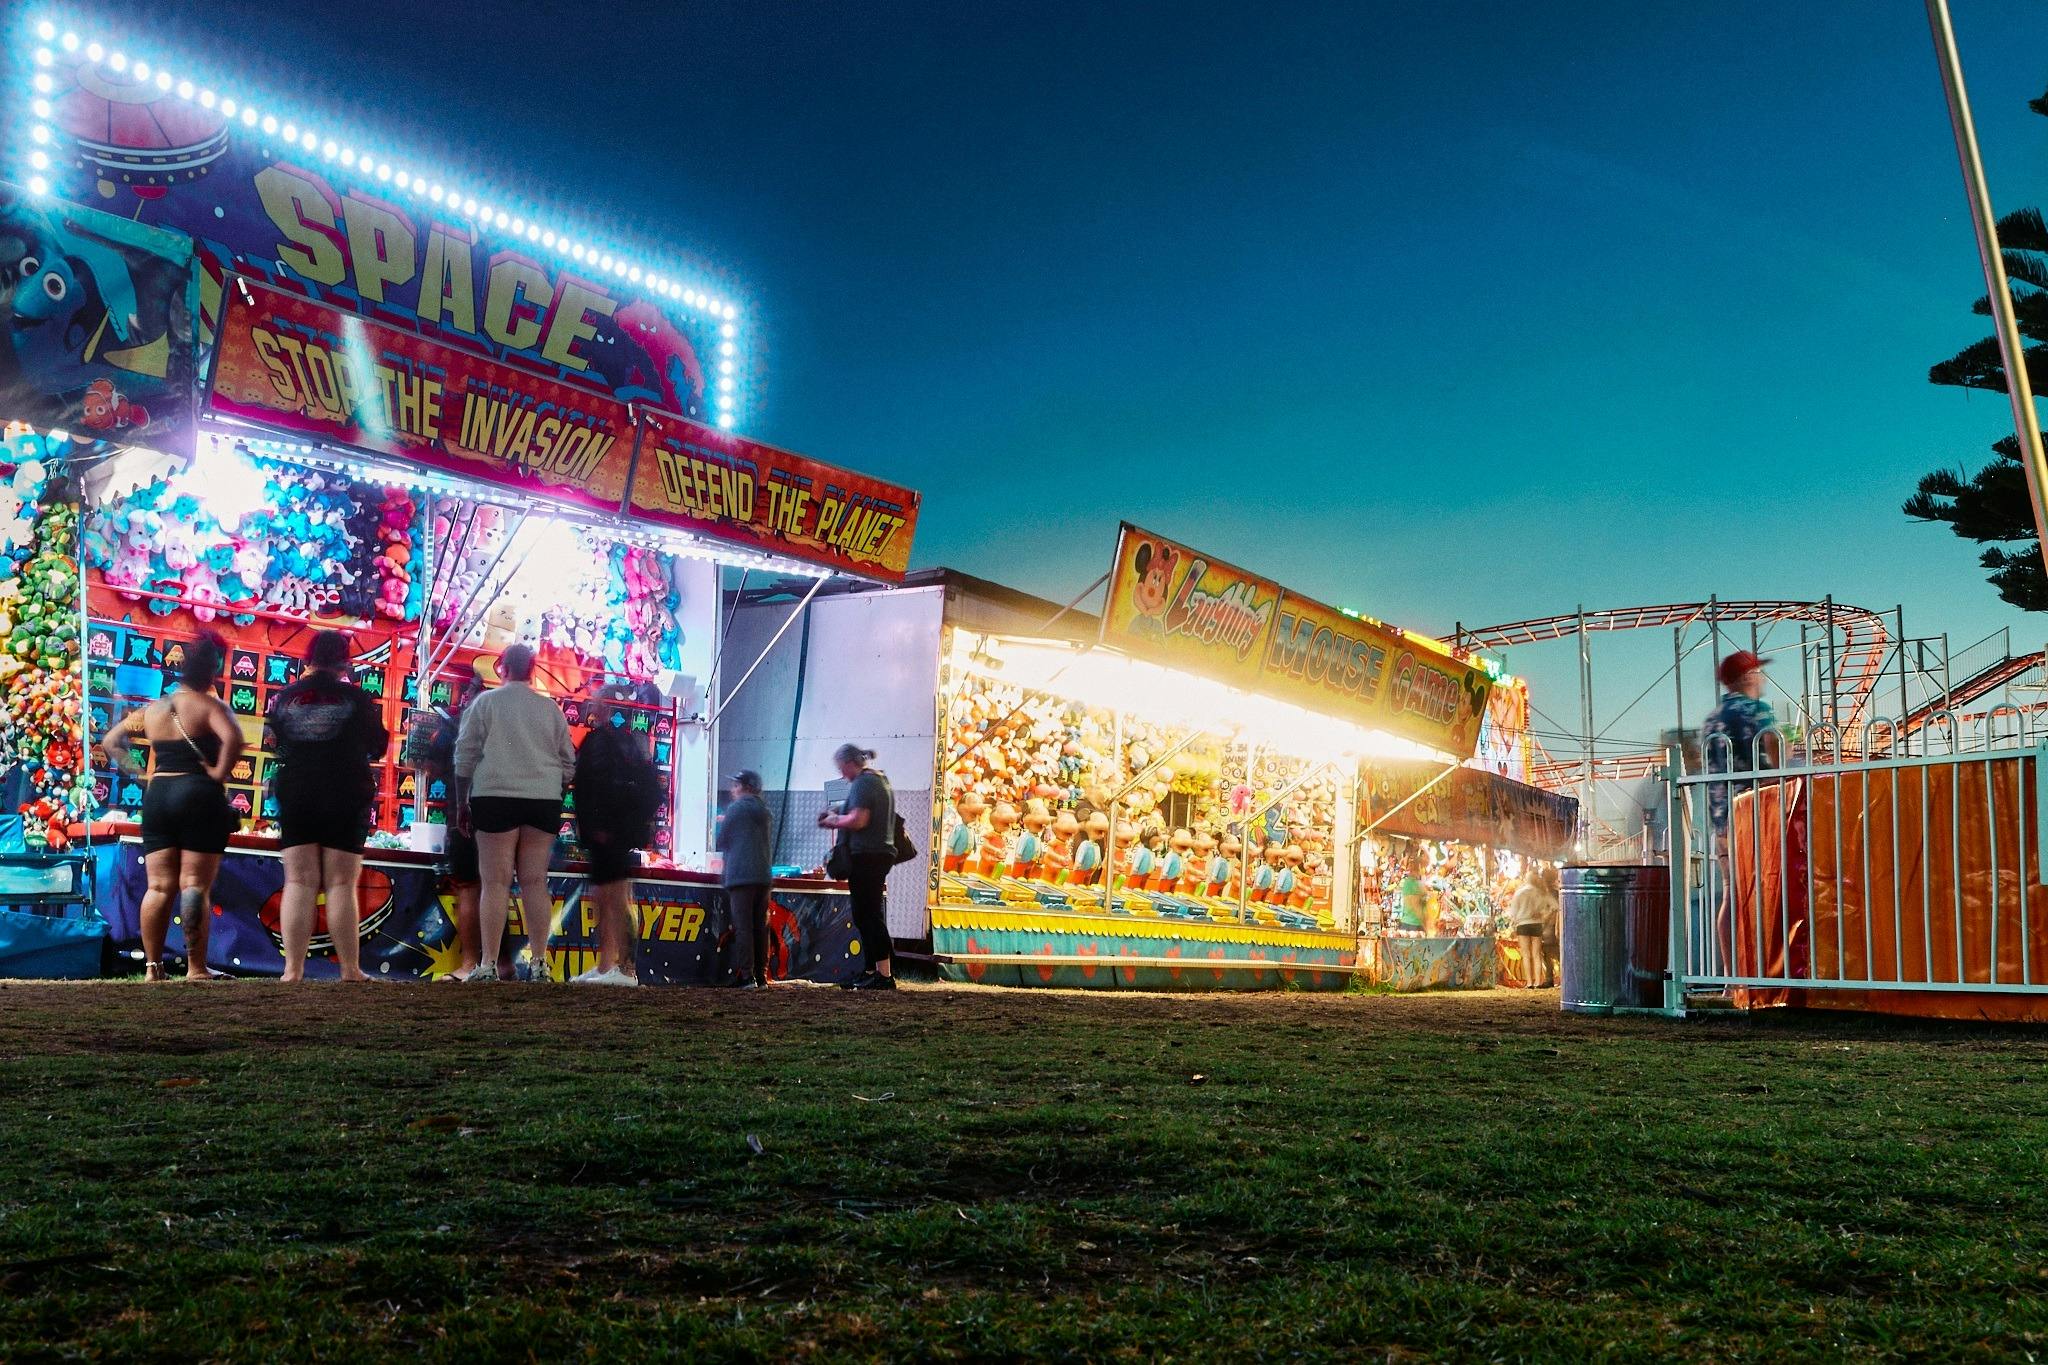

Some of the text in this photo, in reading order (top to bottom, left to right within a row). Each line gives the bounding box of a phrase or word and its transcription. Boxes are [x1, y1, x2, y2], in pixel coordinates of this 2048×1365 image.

[253, 163, 619, 372] SPACE
[250, 326, 615, 482] STOP THE INVASION
[655, 447, 906, 557] DEFEND THE PLANET
[581, 900, 706, 942] PYER
